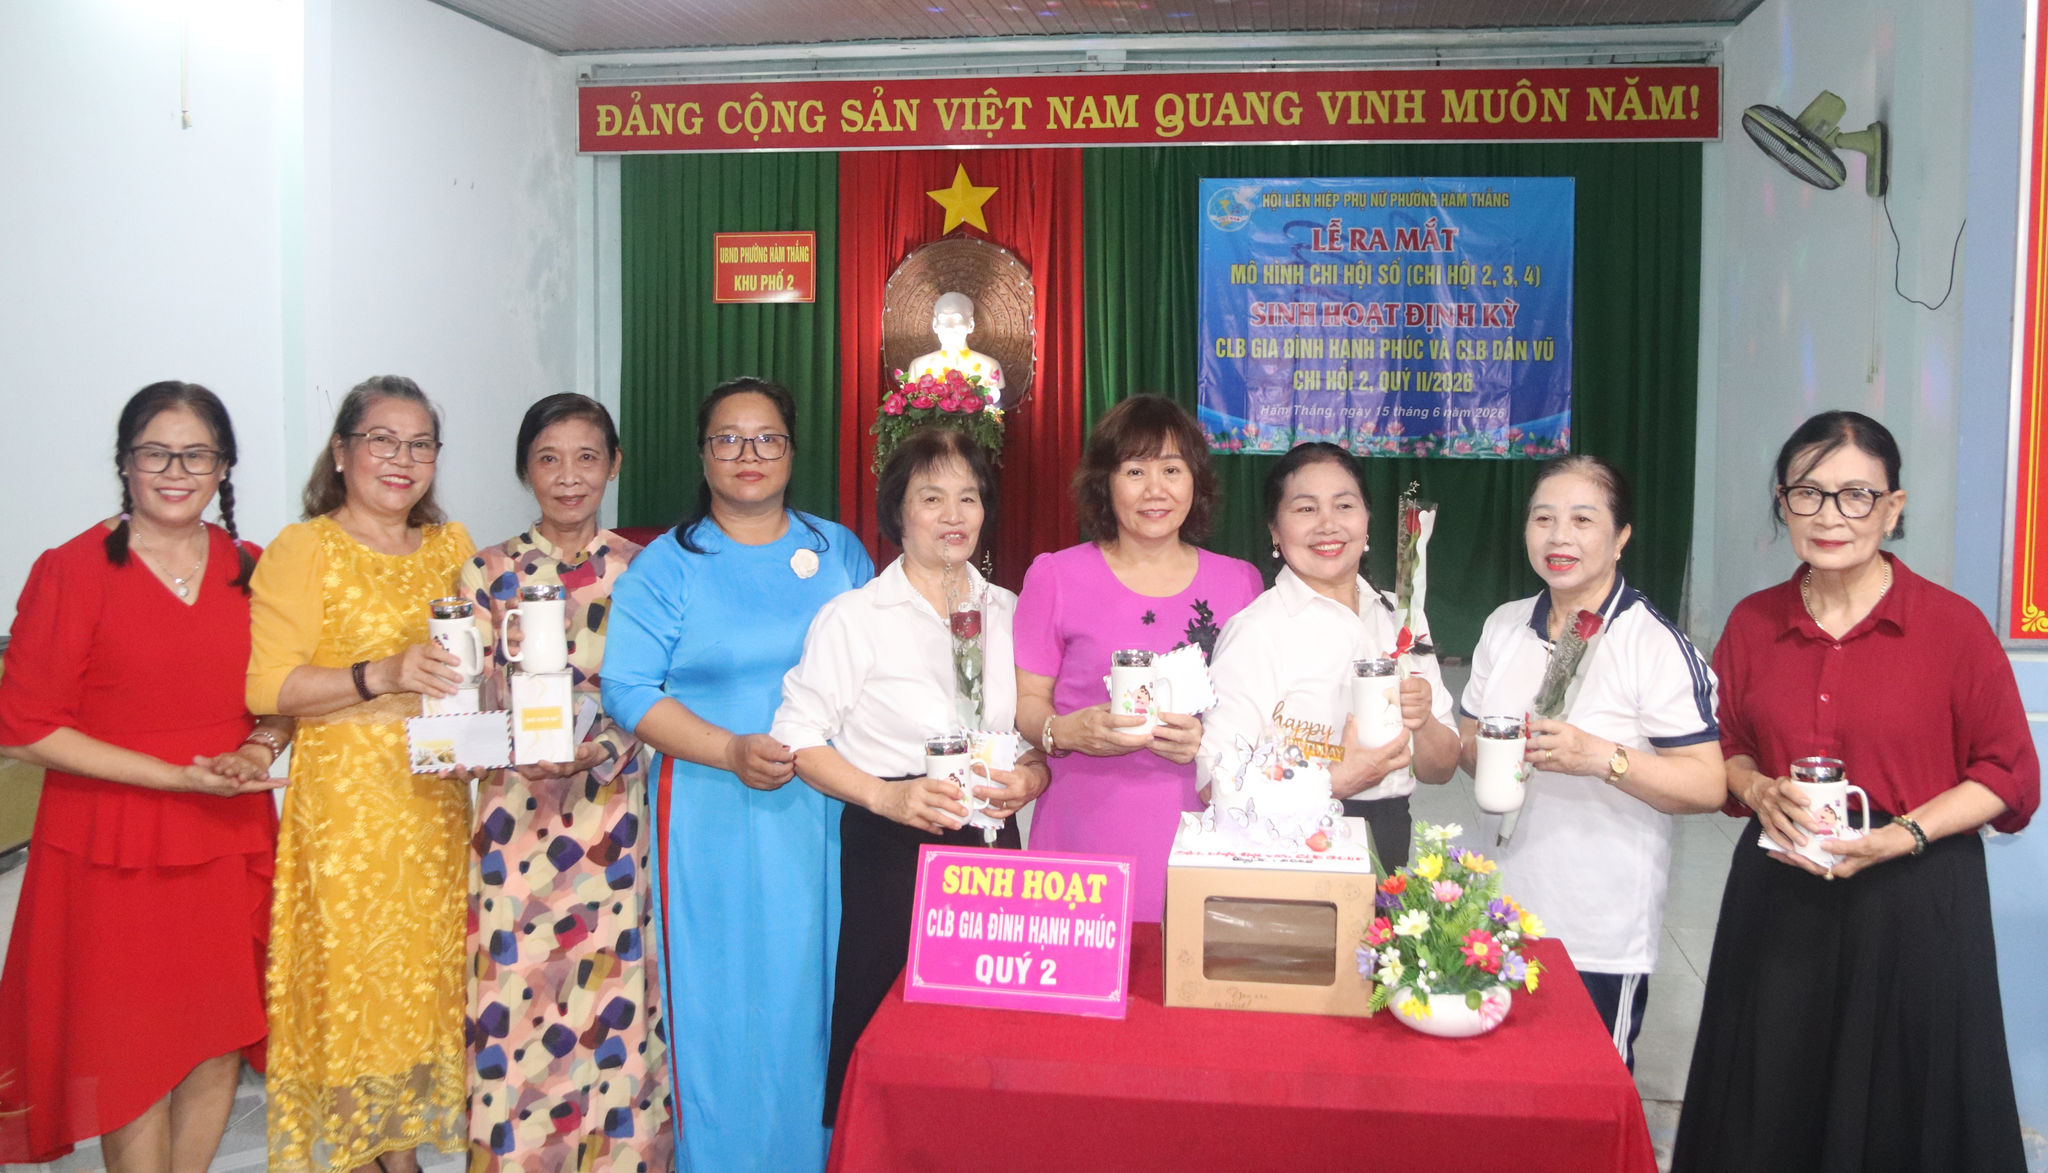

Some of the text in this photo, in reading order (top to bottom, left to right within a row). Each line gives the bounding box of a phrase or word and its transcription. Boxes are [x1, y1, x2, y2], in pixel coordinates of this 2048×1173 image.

[596, 76, 1701, 142] ĐẢNG CỘNG SẢN VIỆT NAM QUANG VINH MUÔN NĂM!
[1262, 190, 1282, 211] HỘI
[1285, 190, 1311, 208] LIÊN
[1314, 190, 1340, 211] HIỆP
[1343, 191, 1367, 211] PHỤ
[1370, 190, 1388, 208] NỮ
[1311, 217, 1460, 252] LỄ RA MẮT
[720, 247, 739, 263] UBND
[734, 268, 795, 291] KHU PHỐ 2
[1230, 256, 1541, 290] MÔ HÌNH CHI HỘI SỐ (CHI HỘI 2, 3, 4)
[1250, 297, 1520, 333] SINH HOẠT ĐỊNH KỲ
[1215, 334, 1555, 363] CLB GIA ĐÌNH HẠNH PHÚC VÀ CLB DÂN VŨ
[1293, 366, 1474, 396] CHI HỘI 2, QUÝ II/2026
[1339, 405, 1372, 419] ngày
[1375, 406, 1390, 417] 15
[1393, 406, 1429, 419] tháng
[1432, 407, 1441, 417] 6
[1443, 405, 1471, 418] năm
[1474, 407, 1506, 418] 2026
[1272, 700, 1335, 741] happy
[942, 864, 1108, 911] SINH HOẠT
[926, 906, 1117, 951] CLB GIA ĐÌNH HẠNH PHÚC
[975, 951, 1057, 985] QUÝ 2
